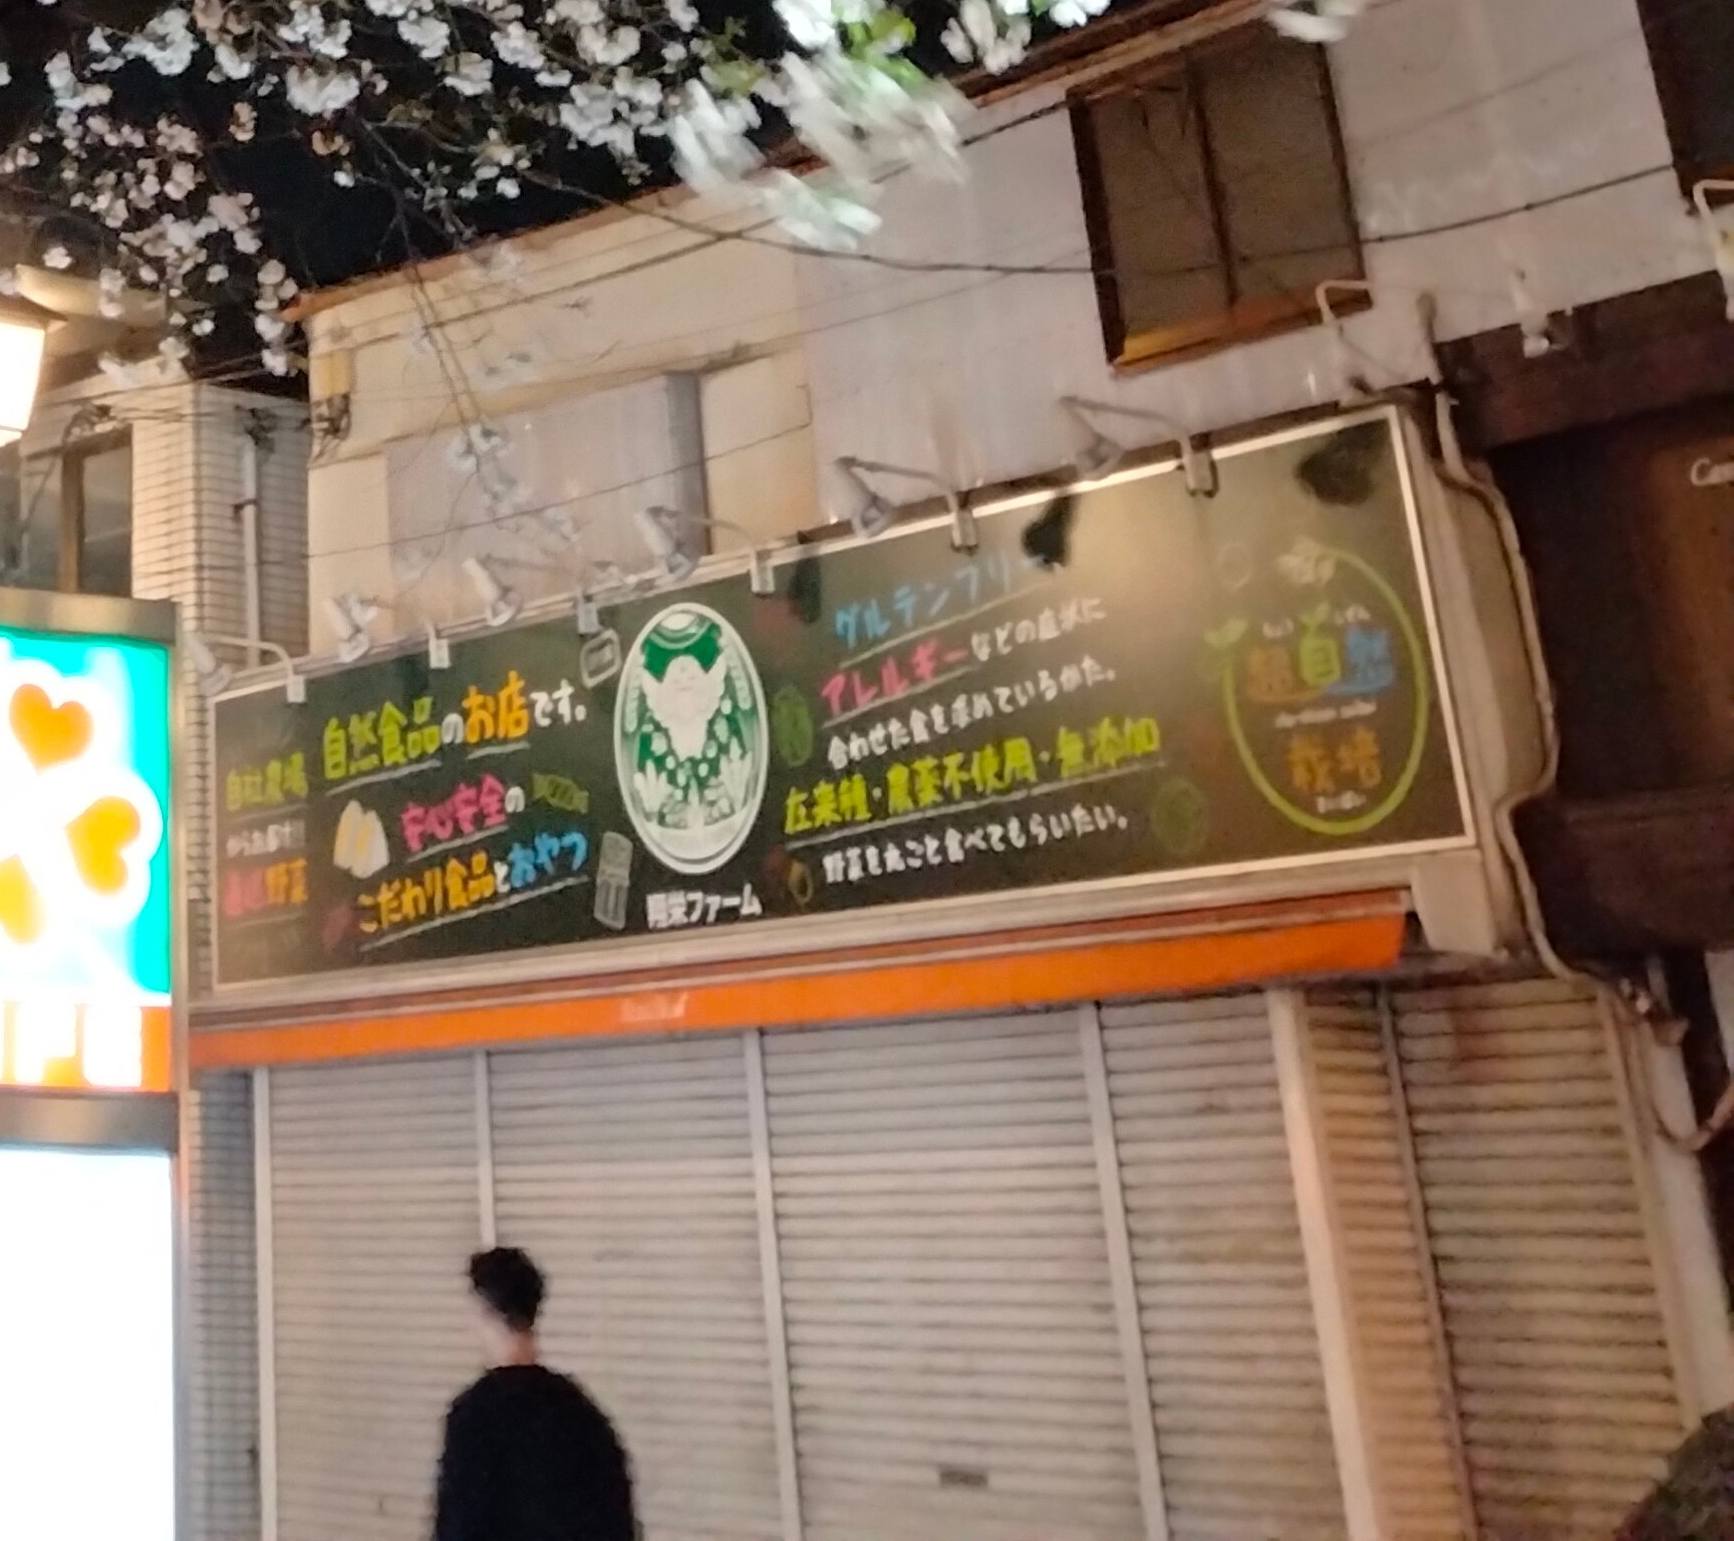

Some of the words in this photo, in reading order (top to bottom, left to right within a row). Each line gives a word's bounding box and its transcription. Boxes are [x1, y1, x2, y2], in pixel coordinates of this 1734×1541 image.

[358, 831, 588, 934] こだわり食品とおやつ
